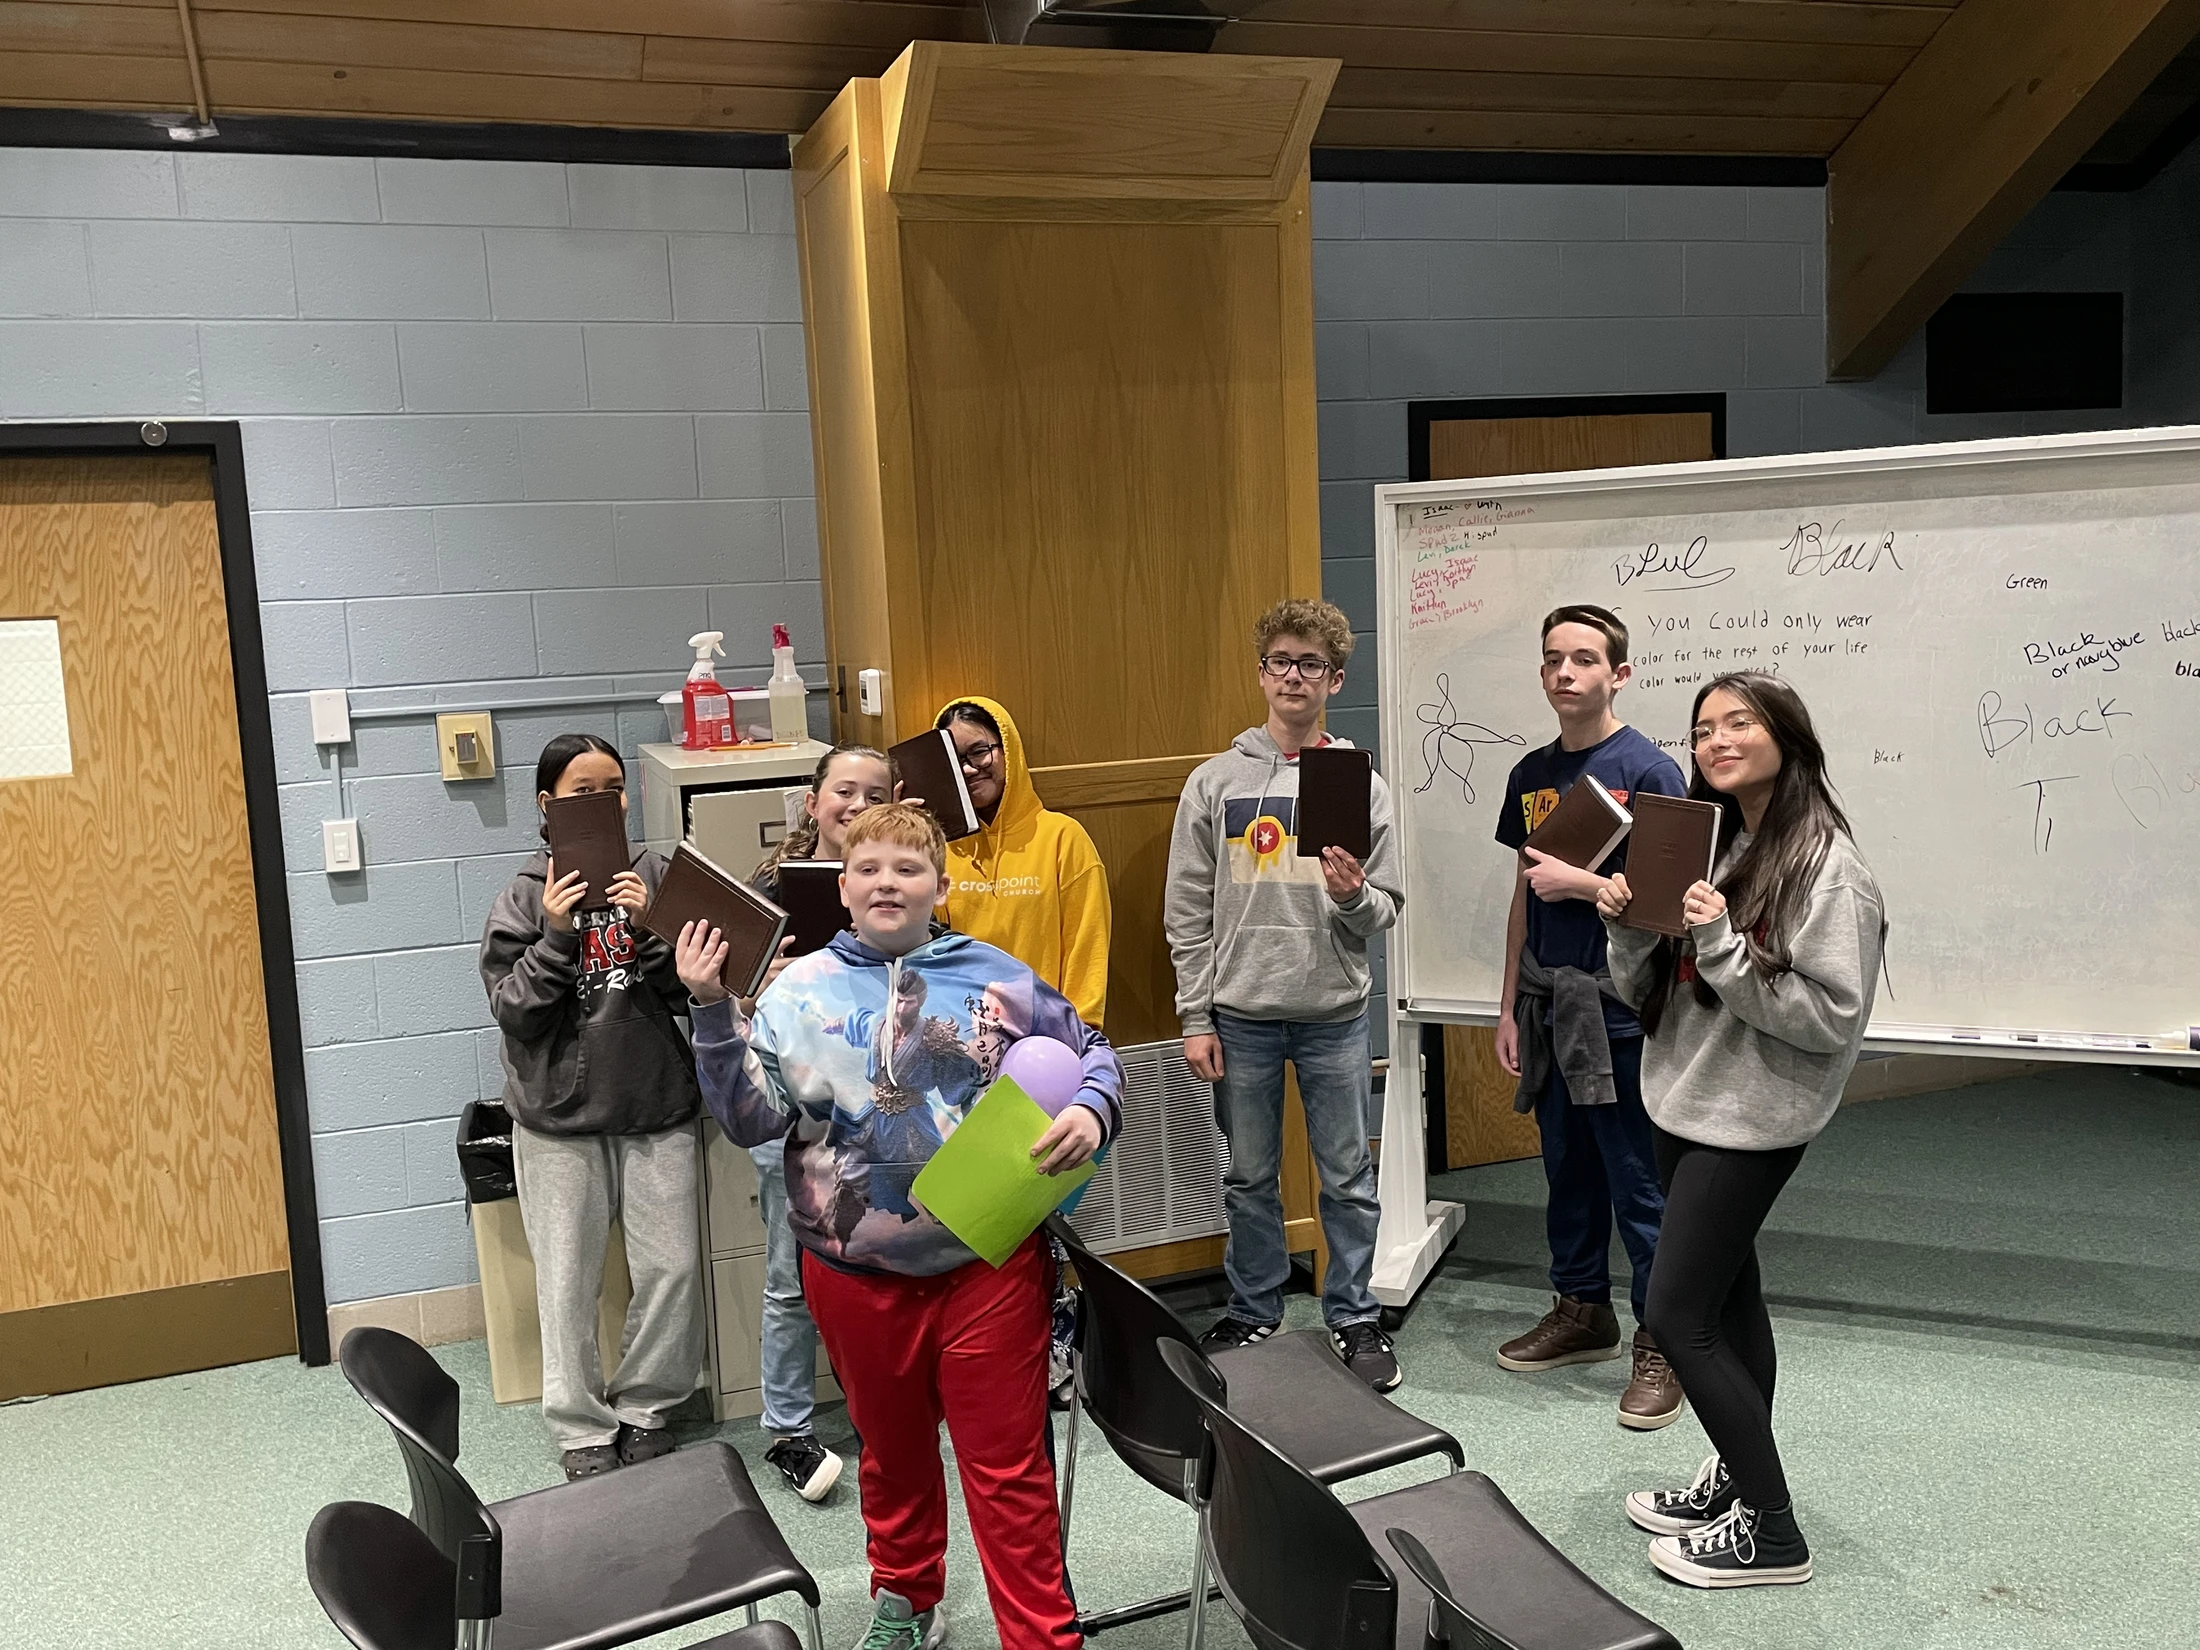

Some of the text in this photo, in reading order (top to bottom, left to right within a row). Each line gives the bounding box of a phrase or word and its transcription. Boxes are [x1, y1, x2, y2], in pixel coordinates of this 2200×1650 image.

[2005, 573, 2048, 590] Green
[1647, 615, 1690, 637] you
[1783, 612, 1822, 634] only
[1836, 614, 1872, 628] wear
[1633, 638, 1868, 667] color for the rest of your life
[2023, 632, 2105, 665] Black
[2052, 662, 2070, 679] or
[1639, 675, 1664, 689] color
[1674, 672, 1701, 684] would
[1978, 690, 2133, 758] Black
[1873, 748, 1905, 764] Black
[1538, 796, 1553, 813] Ar
[1003, 888, 1041, 897] CHURCH
